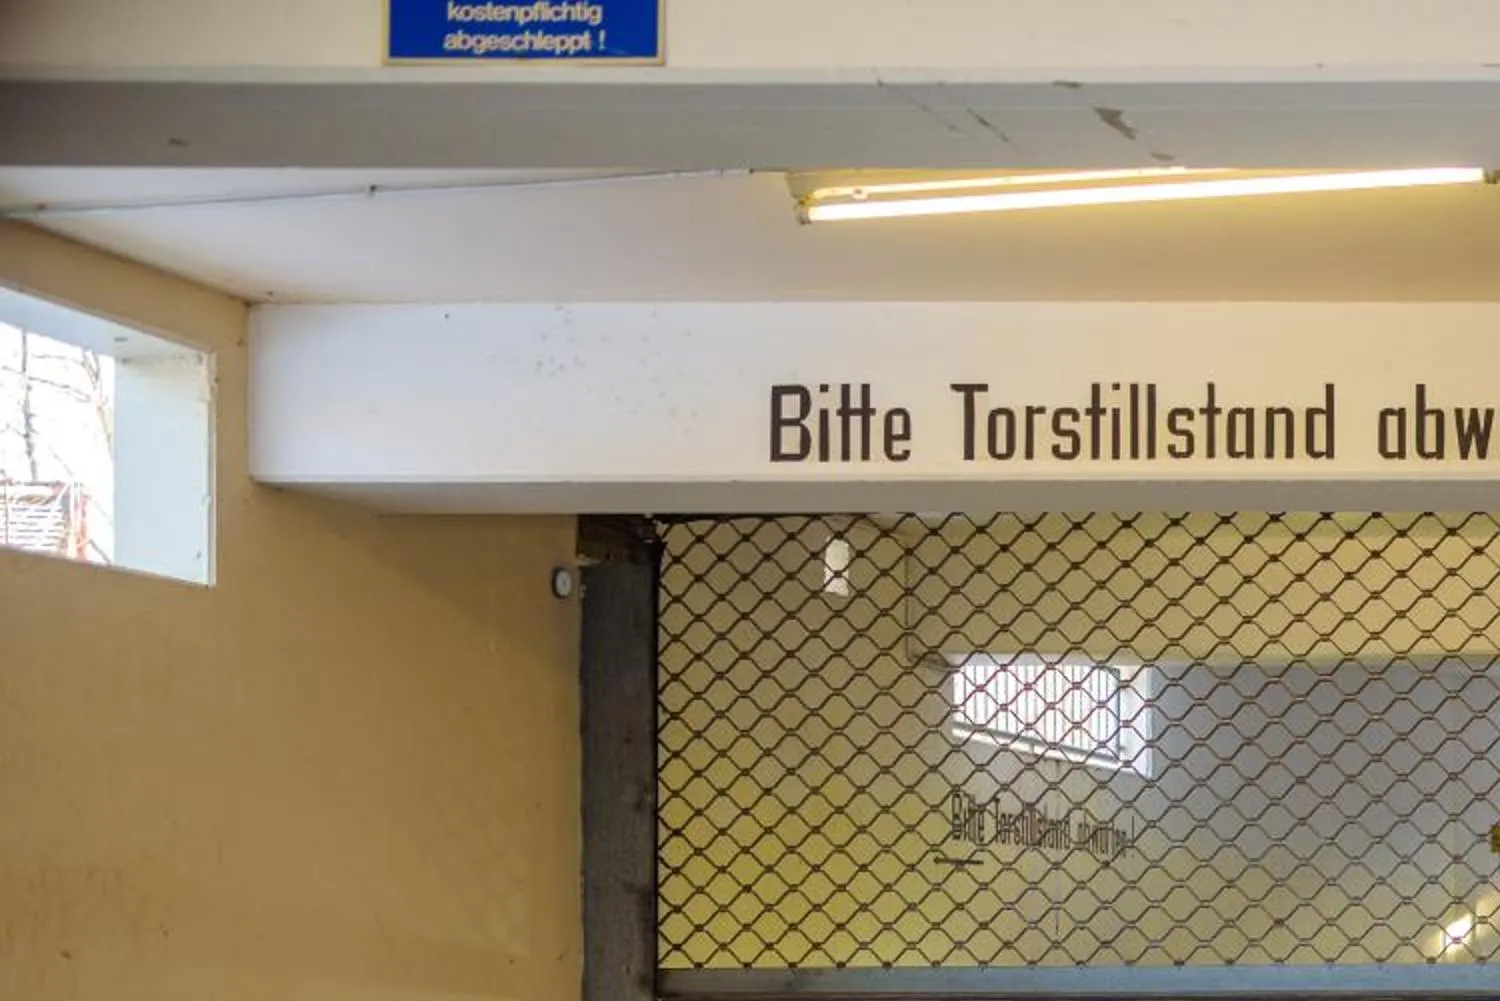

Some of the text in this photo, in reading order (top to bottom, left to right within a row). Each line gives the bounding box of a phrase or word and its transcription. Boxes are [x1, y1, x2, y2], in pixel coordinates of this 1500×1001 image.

[446, 1, 603, 25] kostenpflichtig
[443, 30, 606, 55] abgeschleppt !
[770, 383, 911, 462] Bitte
[950, 382, 1335, 462] Torstillstand
